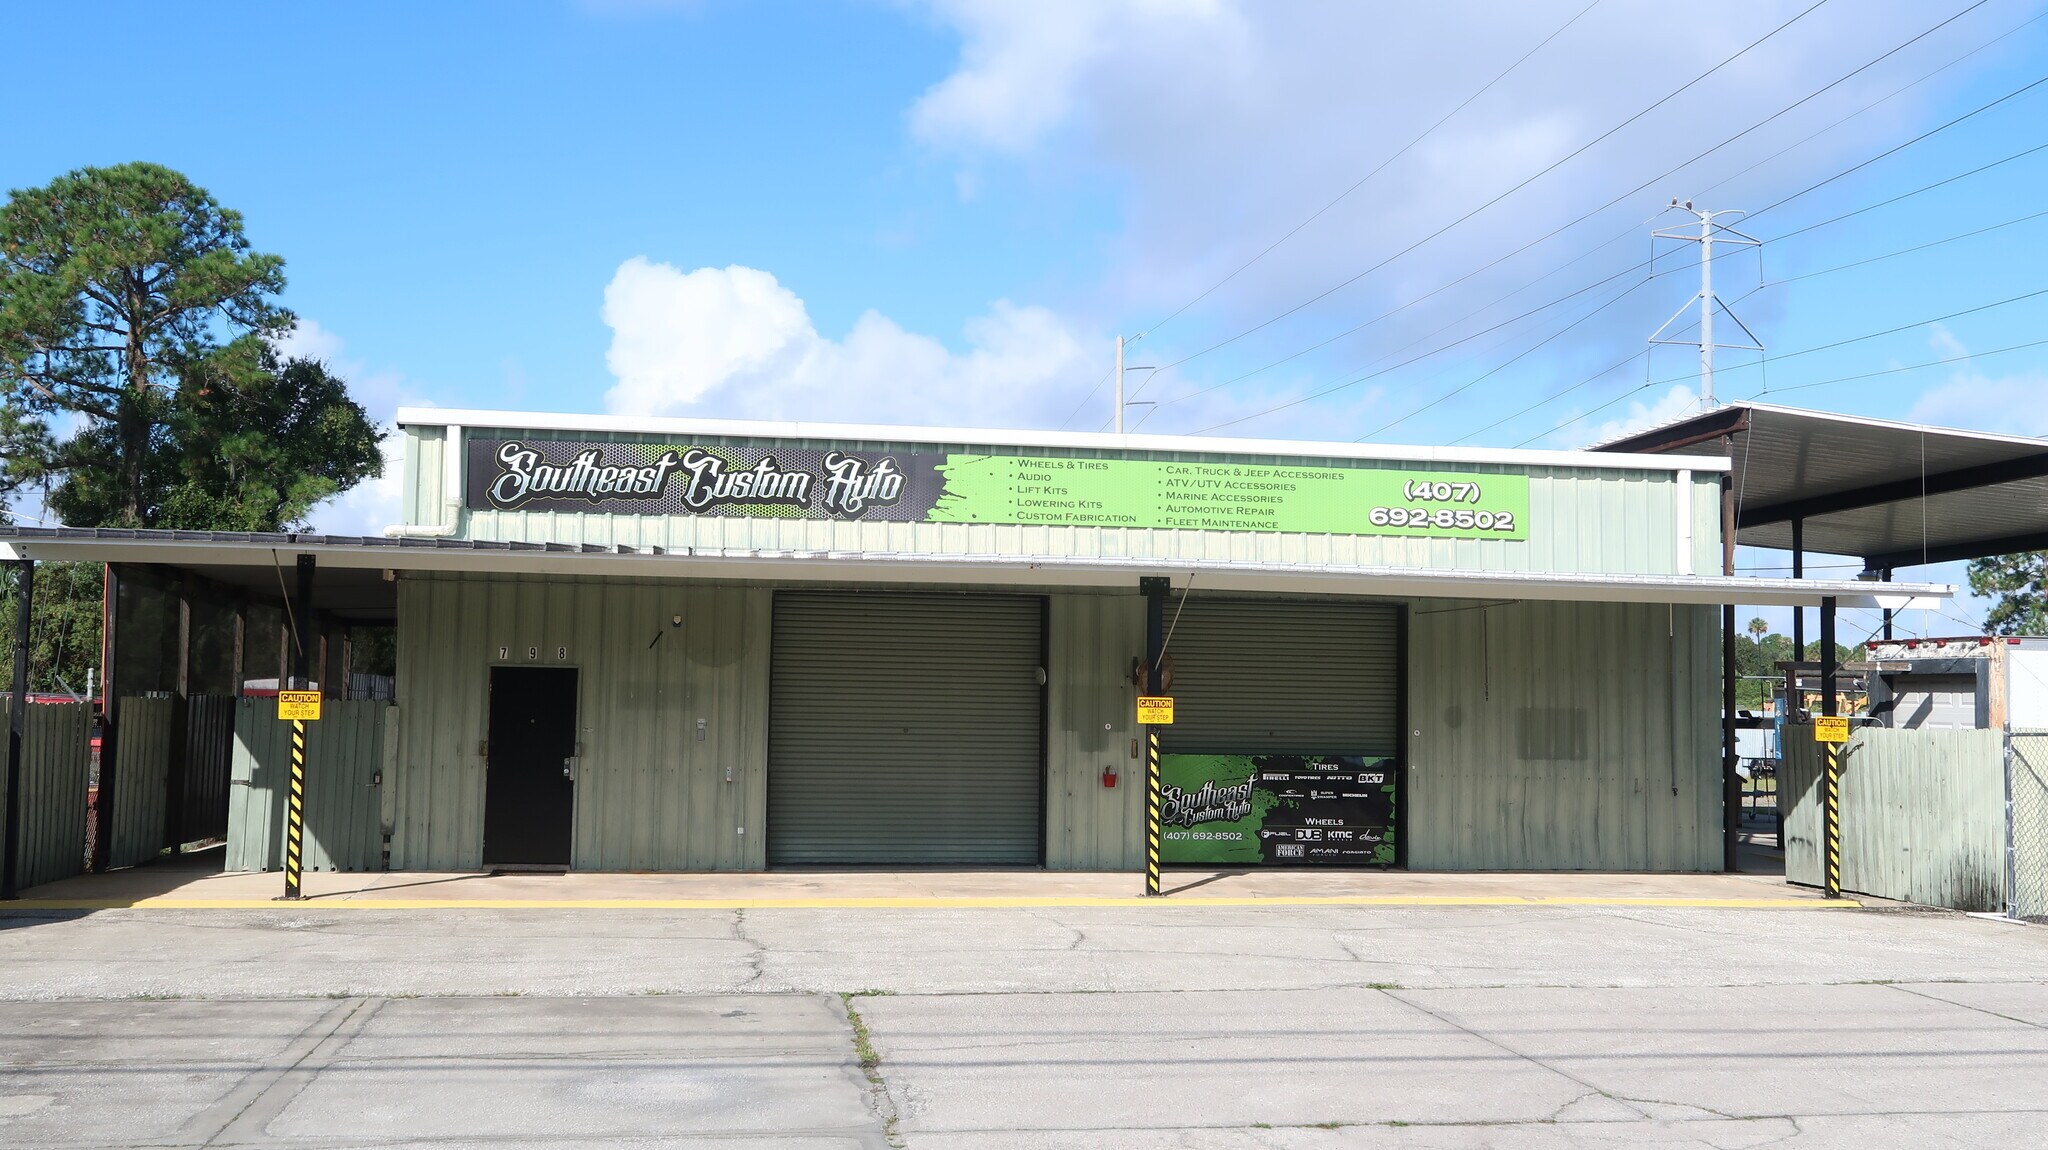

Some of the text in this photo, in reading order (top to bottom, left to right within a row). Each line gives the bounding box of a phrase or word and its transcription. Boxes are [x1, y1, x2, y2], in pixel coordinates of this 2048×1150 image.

[1017, 459, 1109, 470] WHEELS & TIRES
[491, 442, 903, 510] Southeast Custom Auto
[1017, 472, 1051, 482] AUDIO
[1195, 467, 1230, 476] TRUCK
[1233, 468, 1241, 477] &
[1244, 469, 1270, 478] JEEP
[1272, 470, 1345, 480] ACCESSORIES
[1017, 485, 1068, 495] LIFT KITS
[1166, 479, 1297, 491] ATV/UTV ACCESSORIES
[1166, 491, 1284, 504] MARINE ACCESSORIES
[1403, 479, 1481, 504] (407)
[1017, 498, 1103, 509] LOWERING KITS
[1165, 504, 1275, 516] AUTOMOTIVE REPAIR
[1016, 511, 1137, 523] CUSTOM FABRICATION
[1165, 517, 1279, 529] FLEET MAINTENANCE
[1368, 506, 1515, 531] 692-8502
[282, 694, 318, 702] CAUTION
[1312, 763, 1339, 771] TIRES
[1358, 773, 1384, 783] BKT
[1160, 773, 1259, 820] Southeast
[1305, 817, 1344, 826] WHEELS
[1163, 831, 1243, 841] (407) 692-8502
